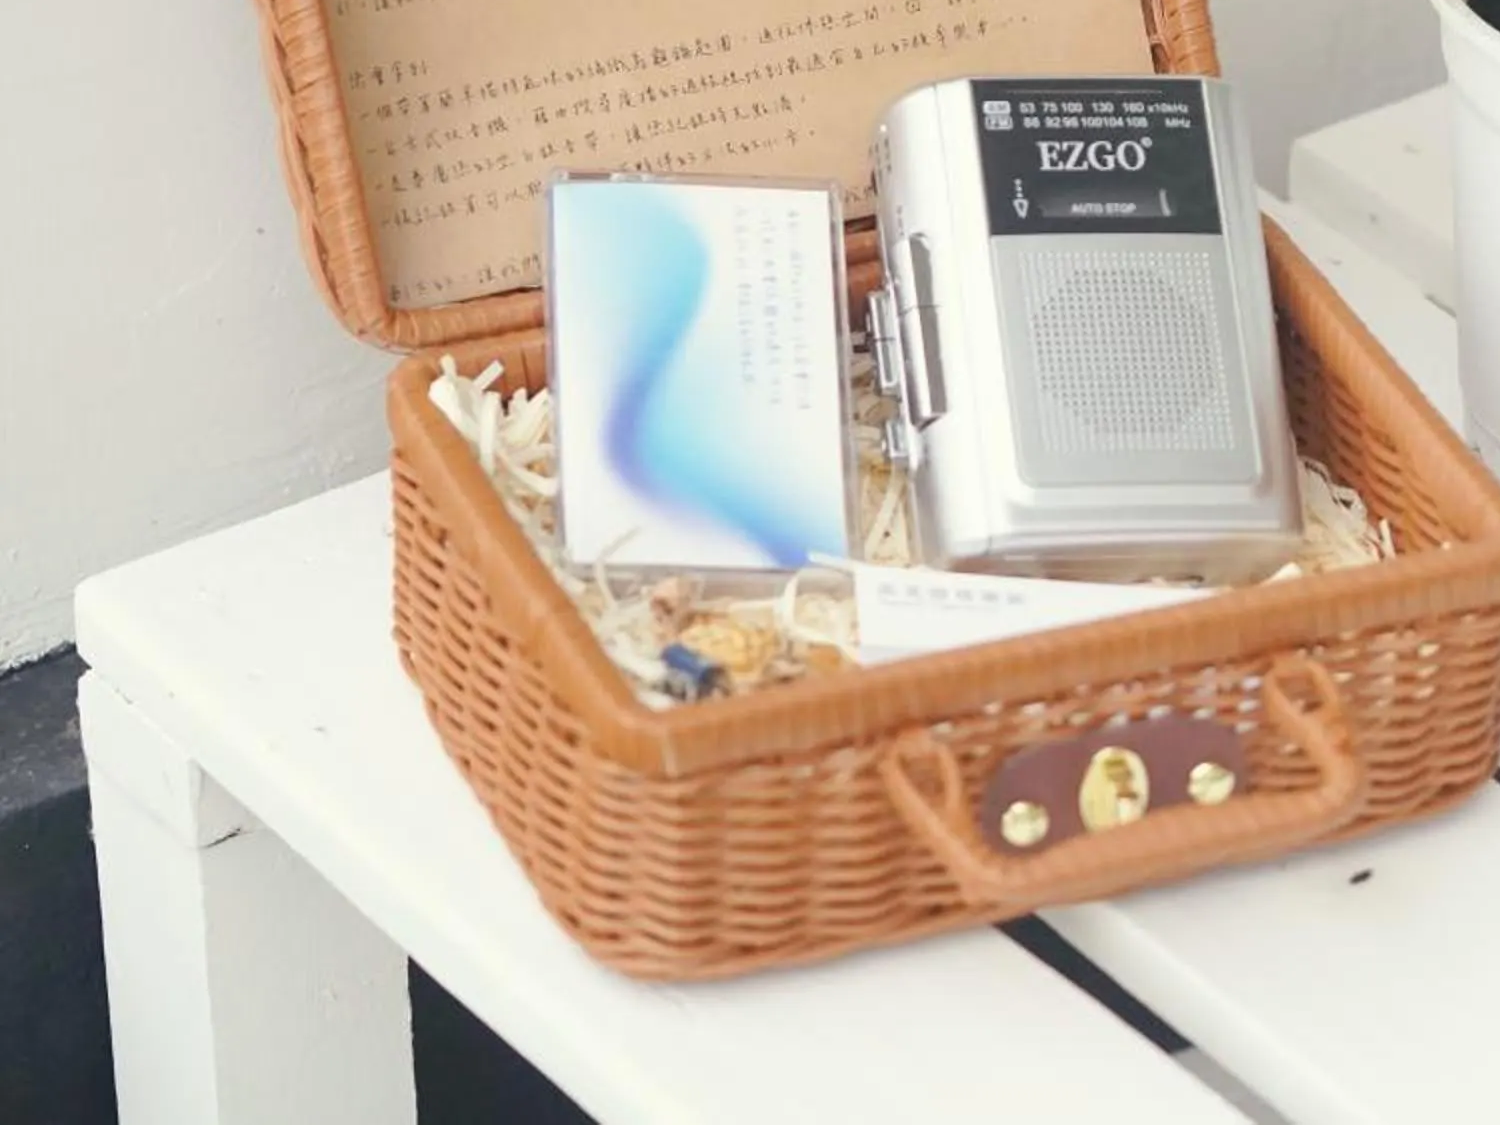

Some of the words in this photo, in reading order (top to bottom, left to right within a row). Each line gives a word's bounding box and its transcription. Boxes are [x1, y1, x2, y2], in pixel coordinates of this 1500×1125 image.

[1036, 139, 1146, 171] EZGO
[1071, 202, 1103, 214] AUTO
[1105, 202, 1137, 214] STOP
